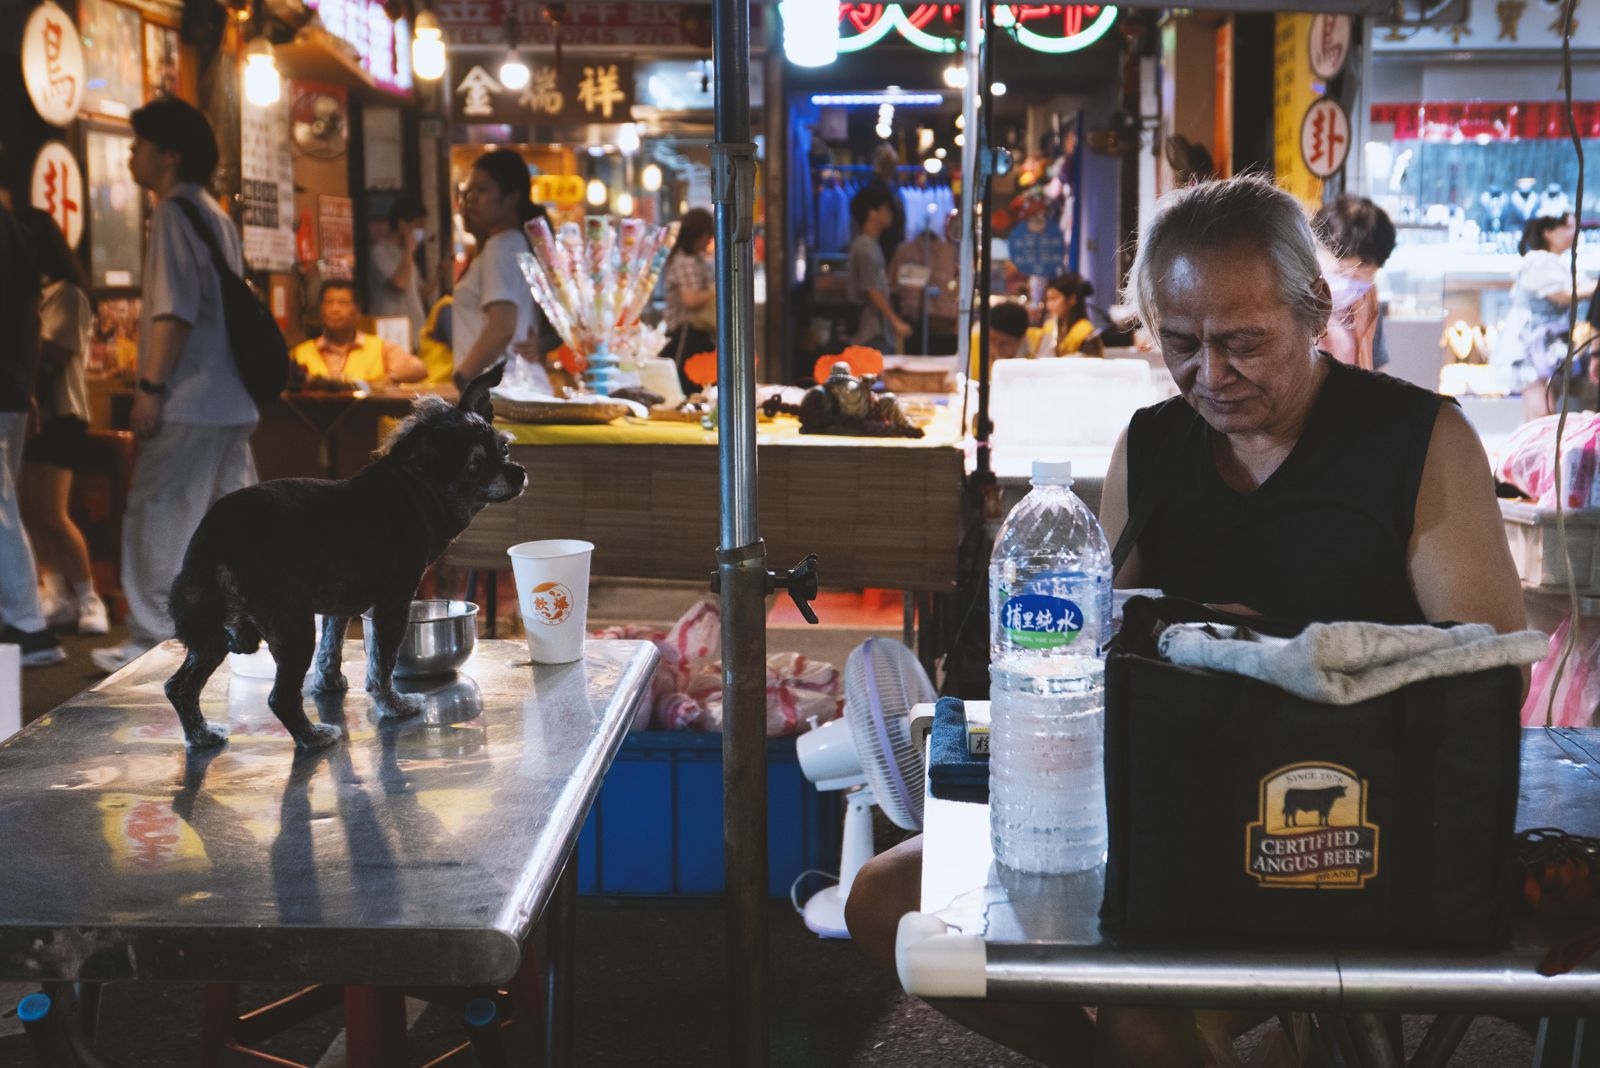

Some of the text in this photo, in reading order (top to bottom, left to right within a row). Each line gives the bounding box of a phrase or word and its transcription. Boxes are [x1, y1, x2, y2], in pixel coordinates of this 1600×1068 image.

[456, 64, 626, 119] 金瑞祥
[1006, 602, 1079, 638] 埔里純水
[1286, 772, 1315, 784] SINCE
[1260, 830, 1359, 855] CERTIFIED
[1253, 853, 1318, 873] ANGUS
[1315, 870, 1355, 881] BRAND
